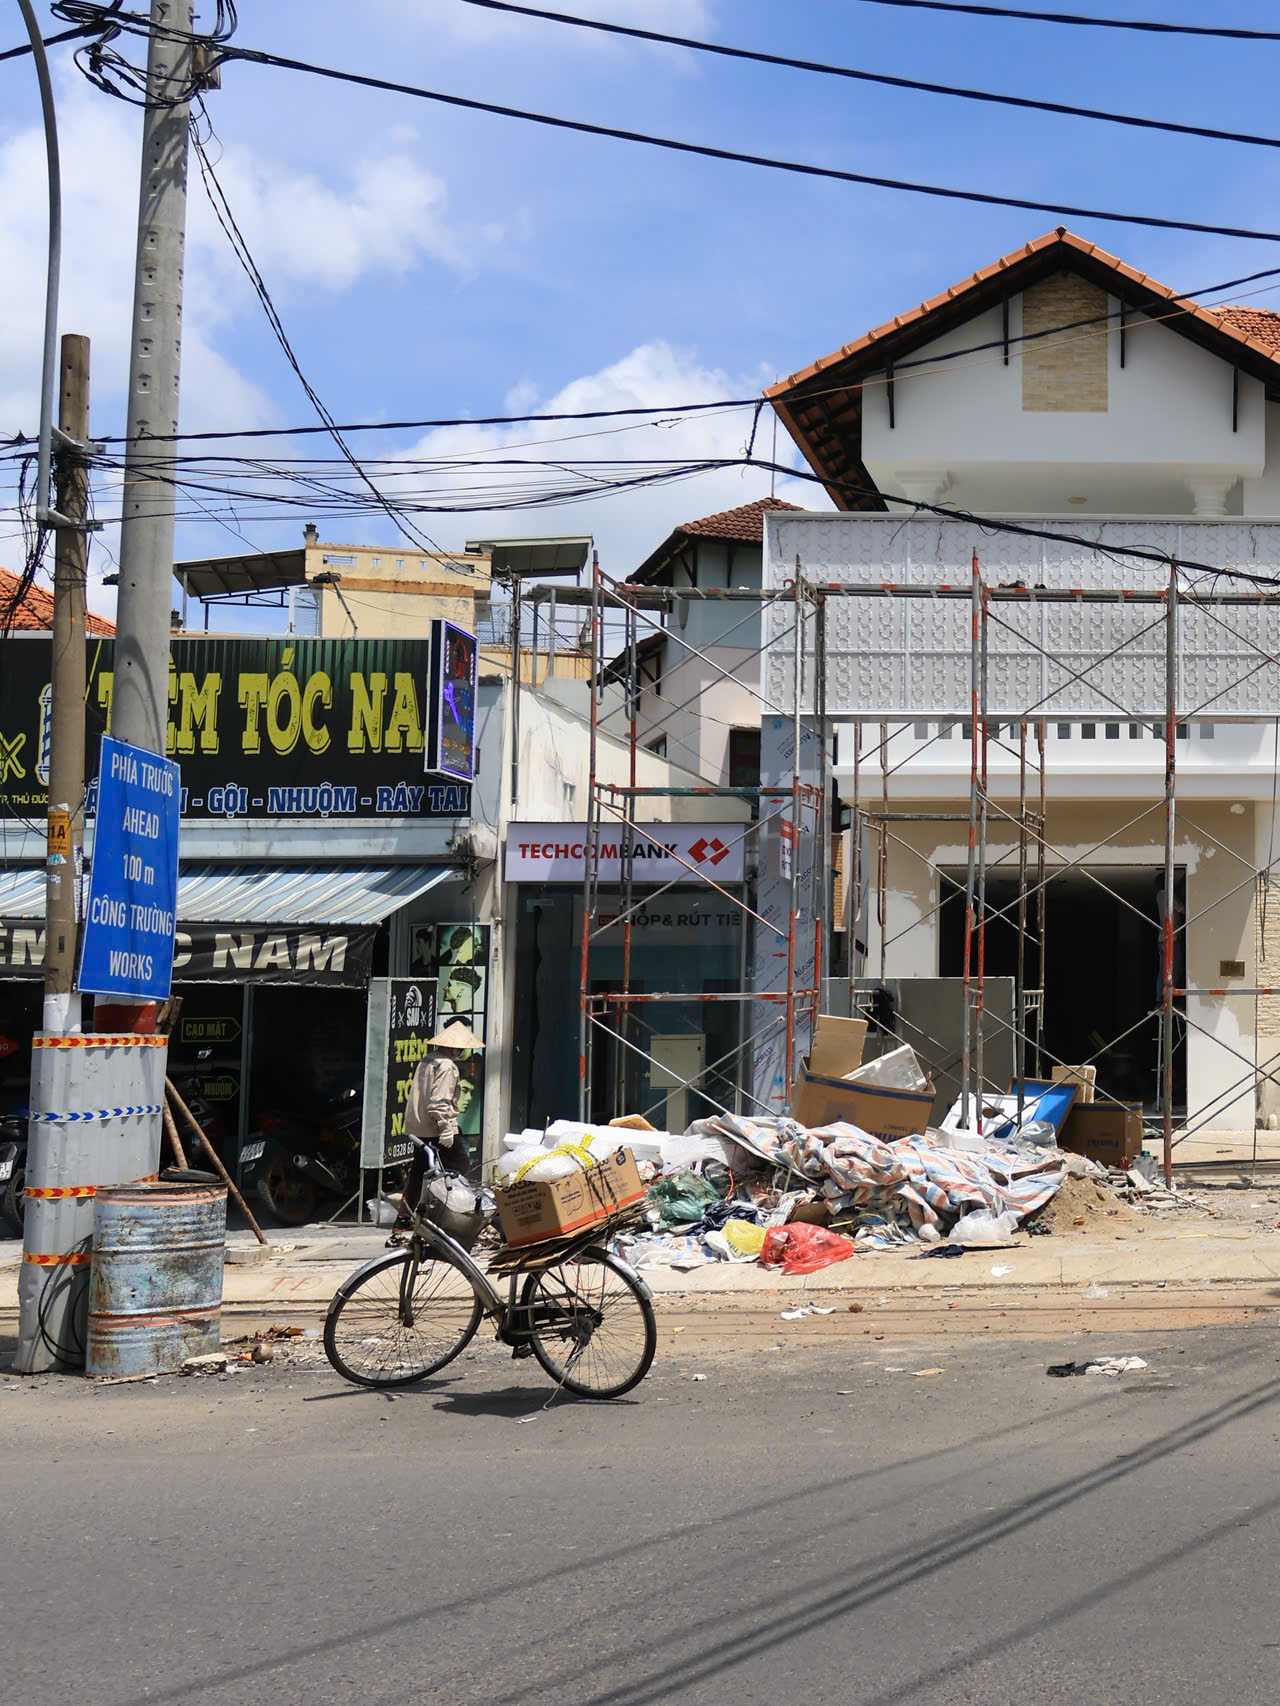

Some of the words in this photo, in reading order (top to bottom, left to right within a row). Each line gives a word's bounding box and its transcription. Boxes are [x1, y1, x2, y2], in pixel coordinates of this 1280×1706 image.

[238, 648, 333, 756] TÓC
[347, 672, 427, 755] NA
[111, 752, 138, 786] PHÍA
[141, 759, 174, 798] TRƯỚC
[12, 792, 30, 804] THỦ
[210, 782, 248, 819] GỘI
[271, 782, 355, 818] NHUỘM
[377, 782, 428, 812] RÁY
[428, 786, 469, 812] TAI
[122, 806, 160, 840] AHEAD
[123, 854, 143, 882] 100
[143, 865, 155, 886] m
[91, 894, 126, 928] CÔNG
[130, 902, 173, 937] TRƯỜNG
[109, 950, 153, 981] WORKS
[213, 933, 349, 972] NAM
[393, 1031, 429, 1069] TIỆM
